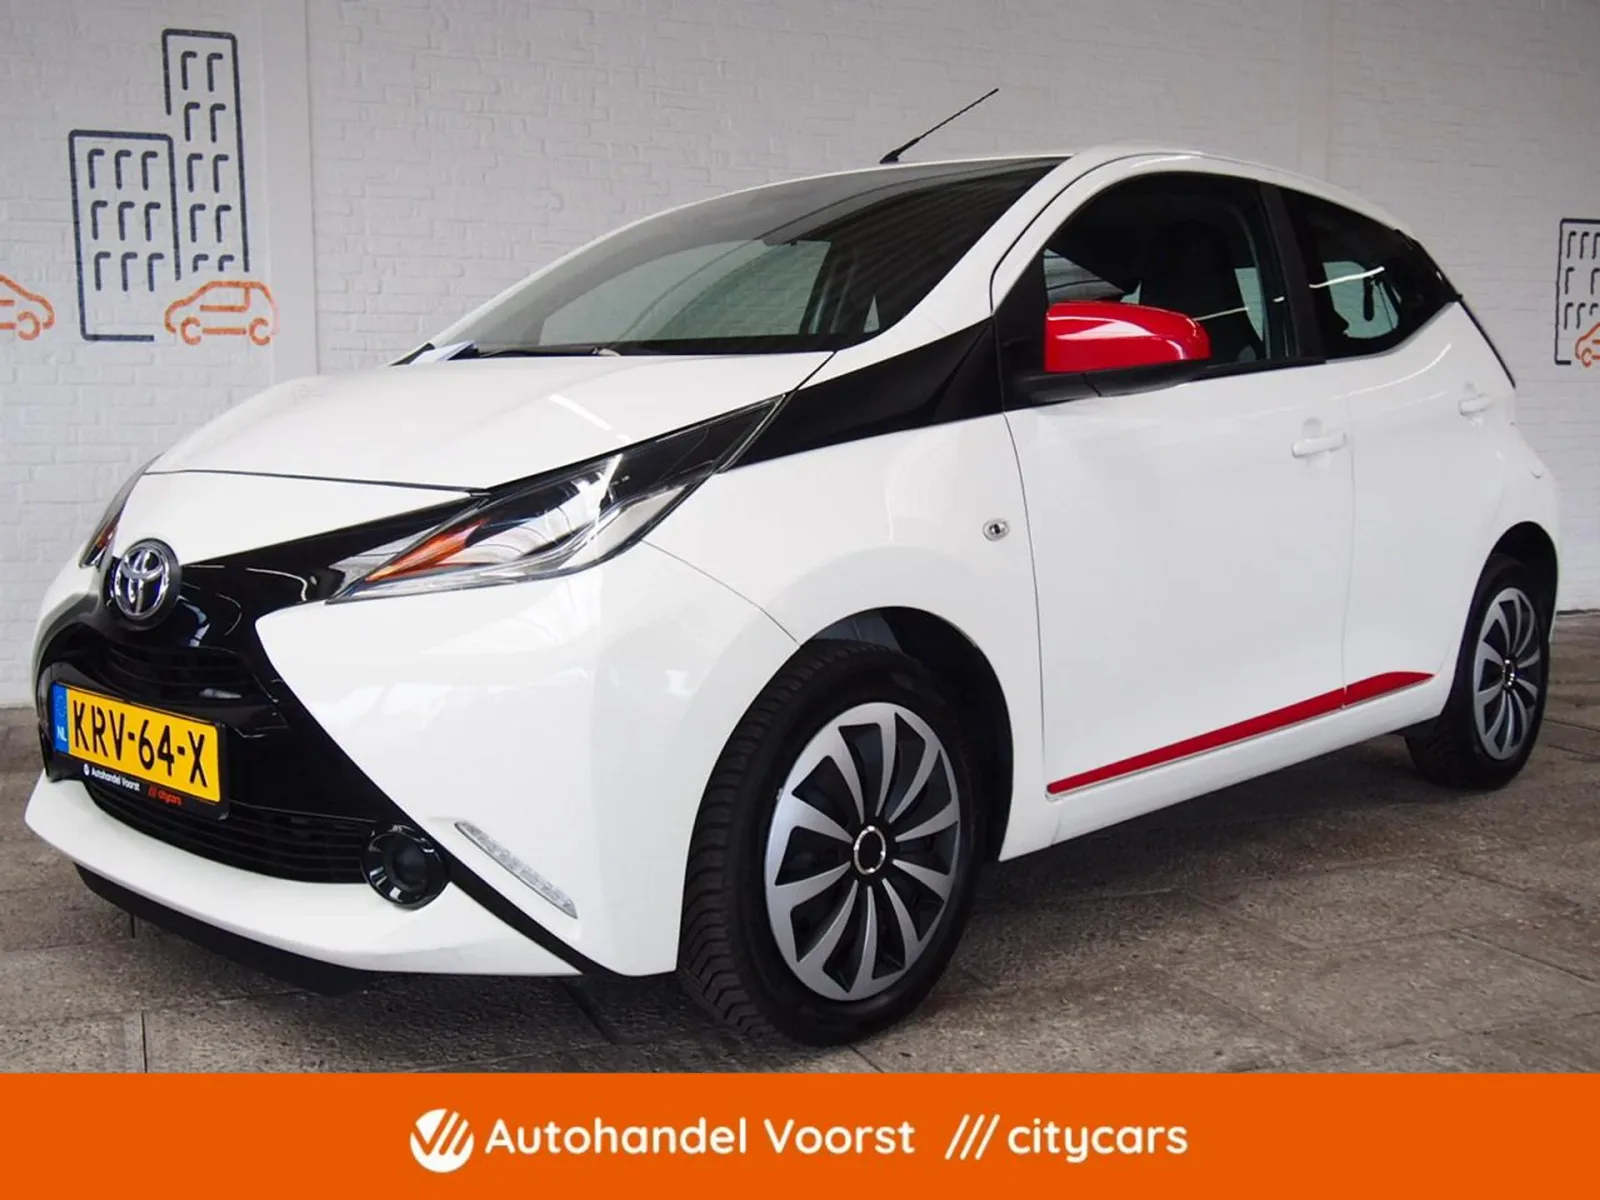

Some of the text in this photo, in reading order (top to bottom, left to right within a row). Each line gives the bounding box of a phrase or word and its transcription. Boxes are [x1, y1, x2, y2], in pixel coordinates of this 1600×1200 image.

[57, 726, 67, 741] NL
[73, 700, 208, 788] KRV-64-X
[91, 766, 121, 785] Autohandel
